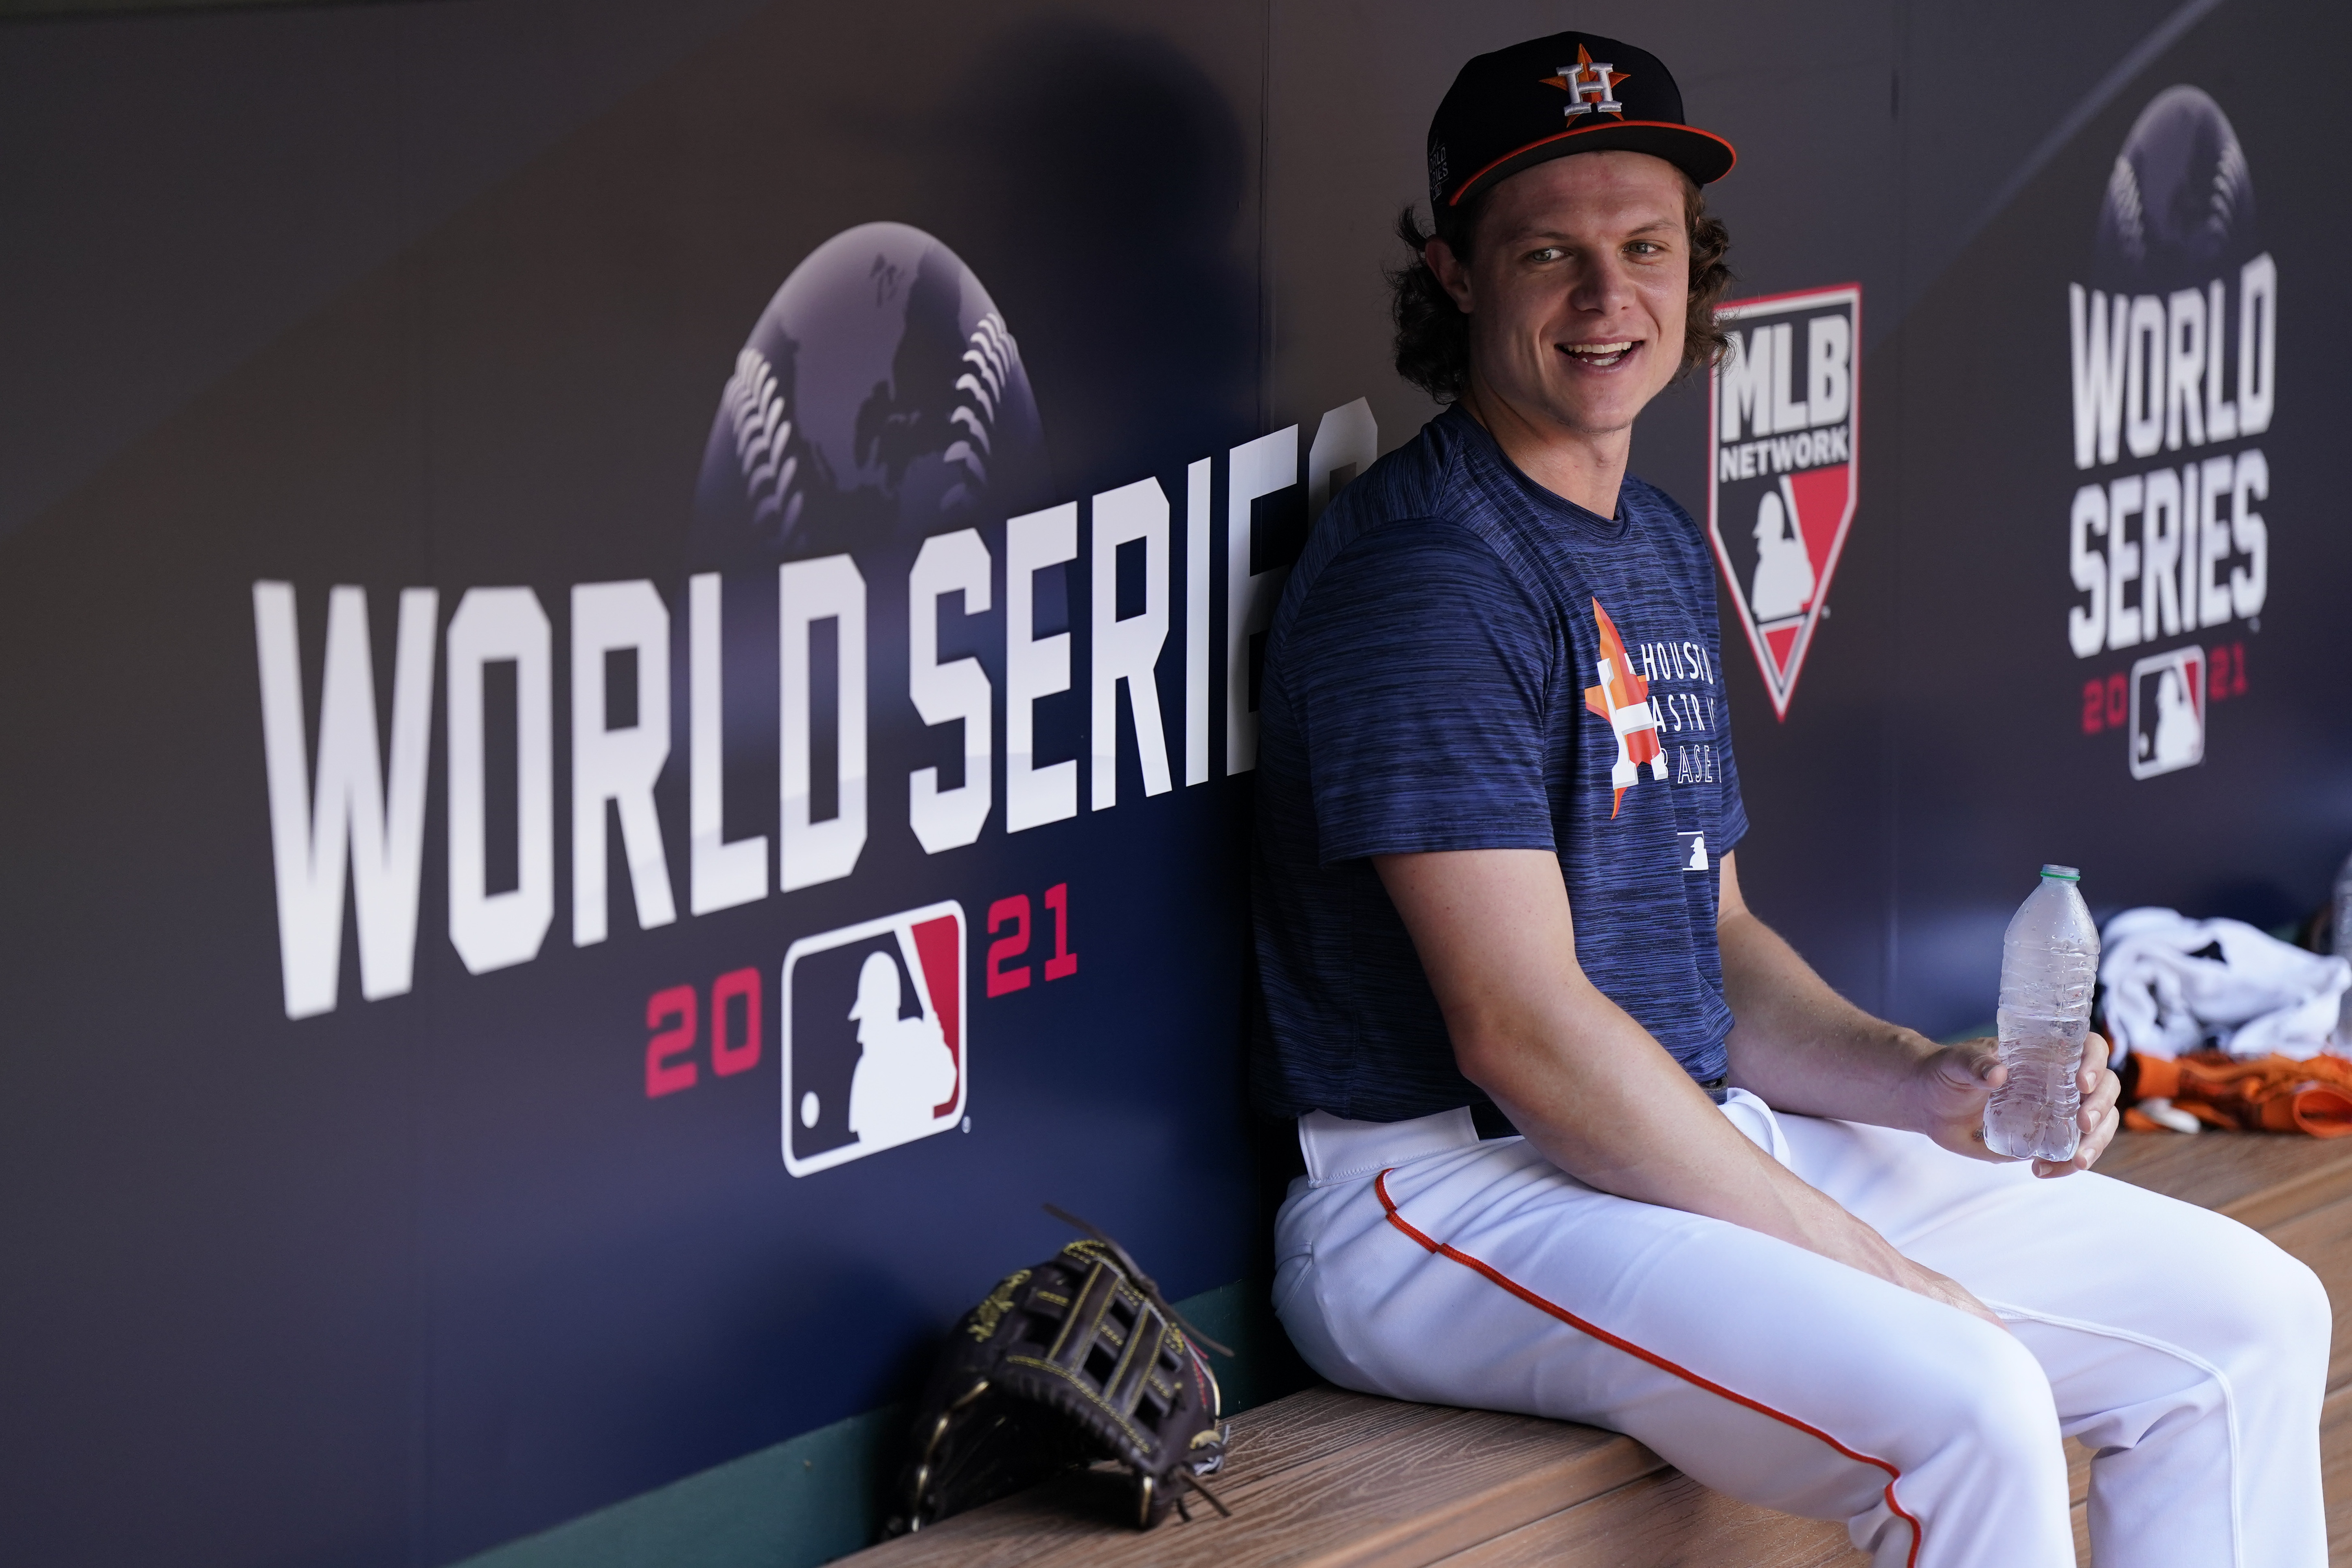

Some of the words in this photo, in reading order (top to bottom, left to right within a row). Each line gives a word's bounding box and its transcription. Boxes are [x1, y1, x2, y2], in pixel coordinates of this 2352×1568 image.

[1429, 147, 1447, 174] ORLD
[1720, 314, 1850, 443] MLB
[2069, 250, 2277, 470] WORLD
[1719, 425, 1849, 483] NETWORK
[2069, 447, 2269, 658] SERIES
[1652, 693, 1715, 732] ASTR
[2082, 672, 2128, 733] 20
[2209, 642, 2248, 702] 21
[252, 553, 867, 1021] WORLD
[645, 967, 762, 1098] 20
[987, 883, 1078, 998] 21
